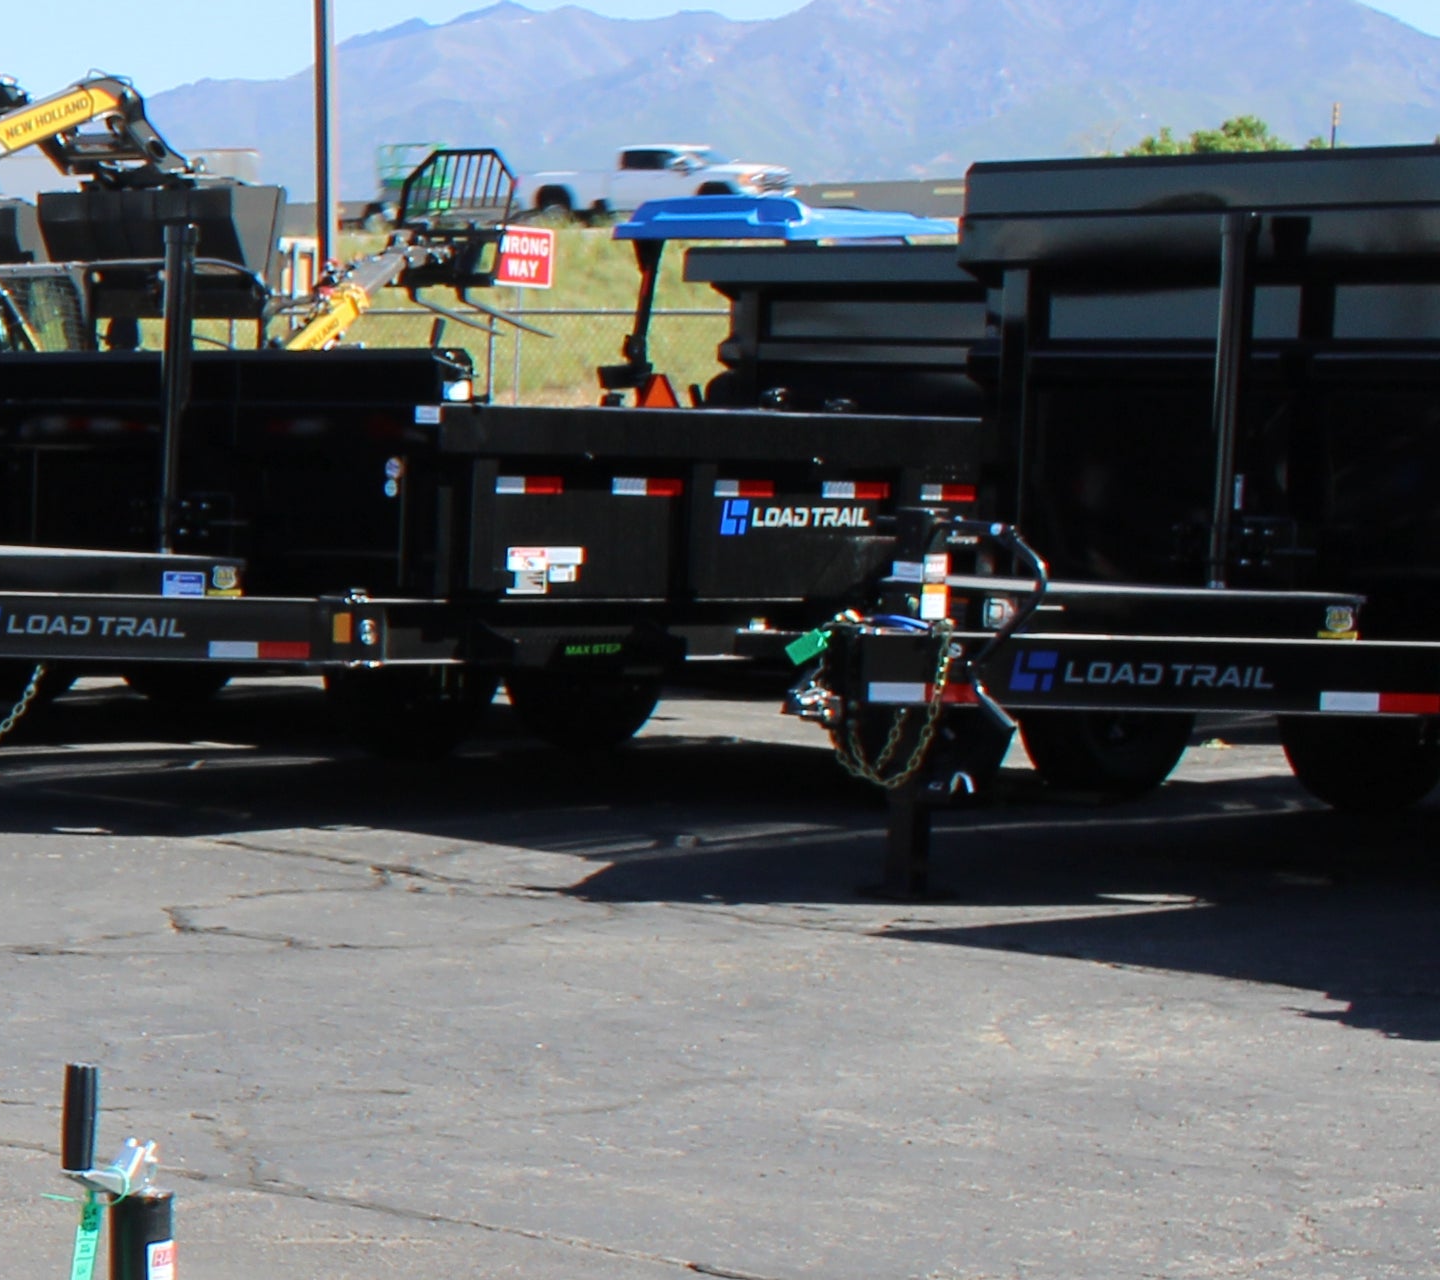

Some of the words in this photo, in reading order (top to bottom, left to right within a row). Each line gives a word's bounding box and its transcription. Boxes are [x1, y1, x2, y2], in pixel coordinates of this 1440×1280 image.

[4, 122, 33, 140] NEW
[35, 98, 89, 129] HOLLAND
[508, 259, 539, 278] WAY
[752, 507, 809, 527] LOAD
[811, 507, 870, 527] TRAIL
[6, 614, 91, 635] LOAD
[97, 616, 186, 638] TRAIL
[565, 645, 590, 655] MAX
[1064, 661, 1163, 685] LOAD
[1170, 664, 1274, 689] TRAIL
